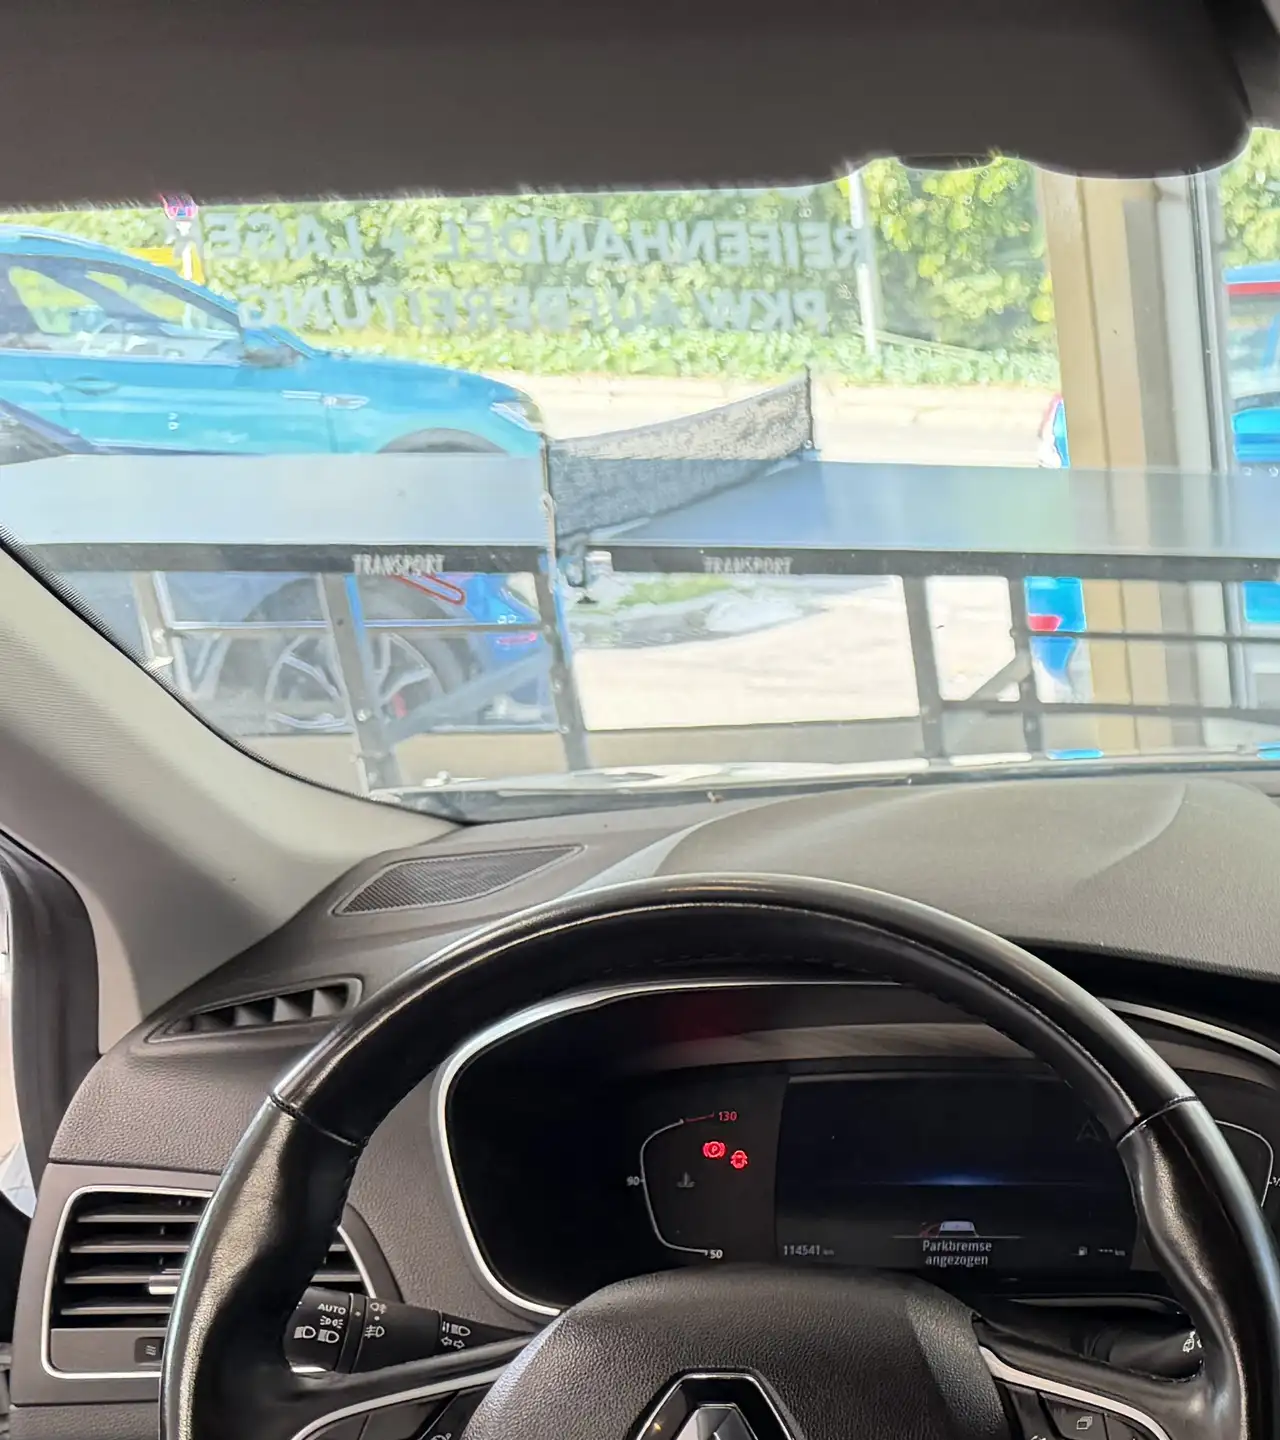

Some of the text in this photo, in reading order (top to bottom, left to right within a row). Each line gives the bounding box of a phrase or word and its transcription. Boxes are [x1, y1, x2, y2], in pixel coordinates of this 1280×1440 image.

[353, 553, 445, 575] TRANSPORT
[703, 556, 795, 575] TRANSPORT
[719, 1111, 738, 1121] 130
[784, 1245, 821, 1257] 114541
[922, 1240, 993, 1253] Parkbremse
[710, 1249, 723, 1259] 50
[924, 1255, 989, 1268] angezogen
[317, 1302, 347, 1316] AUTO
